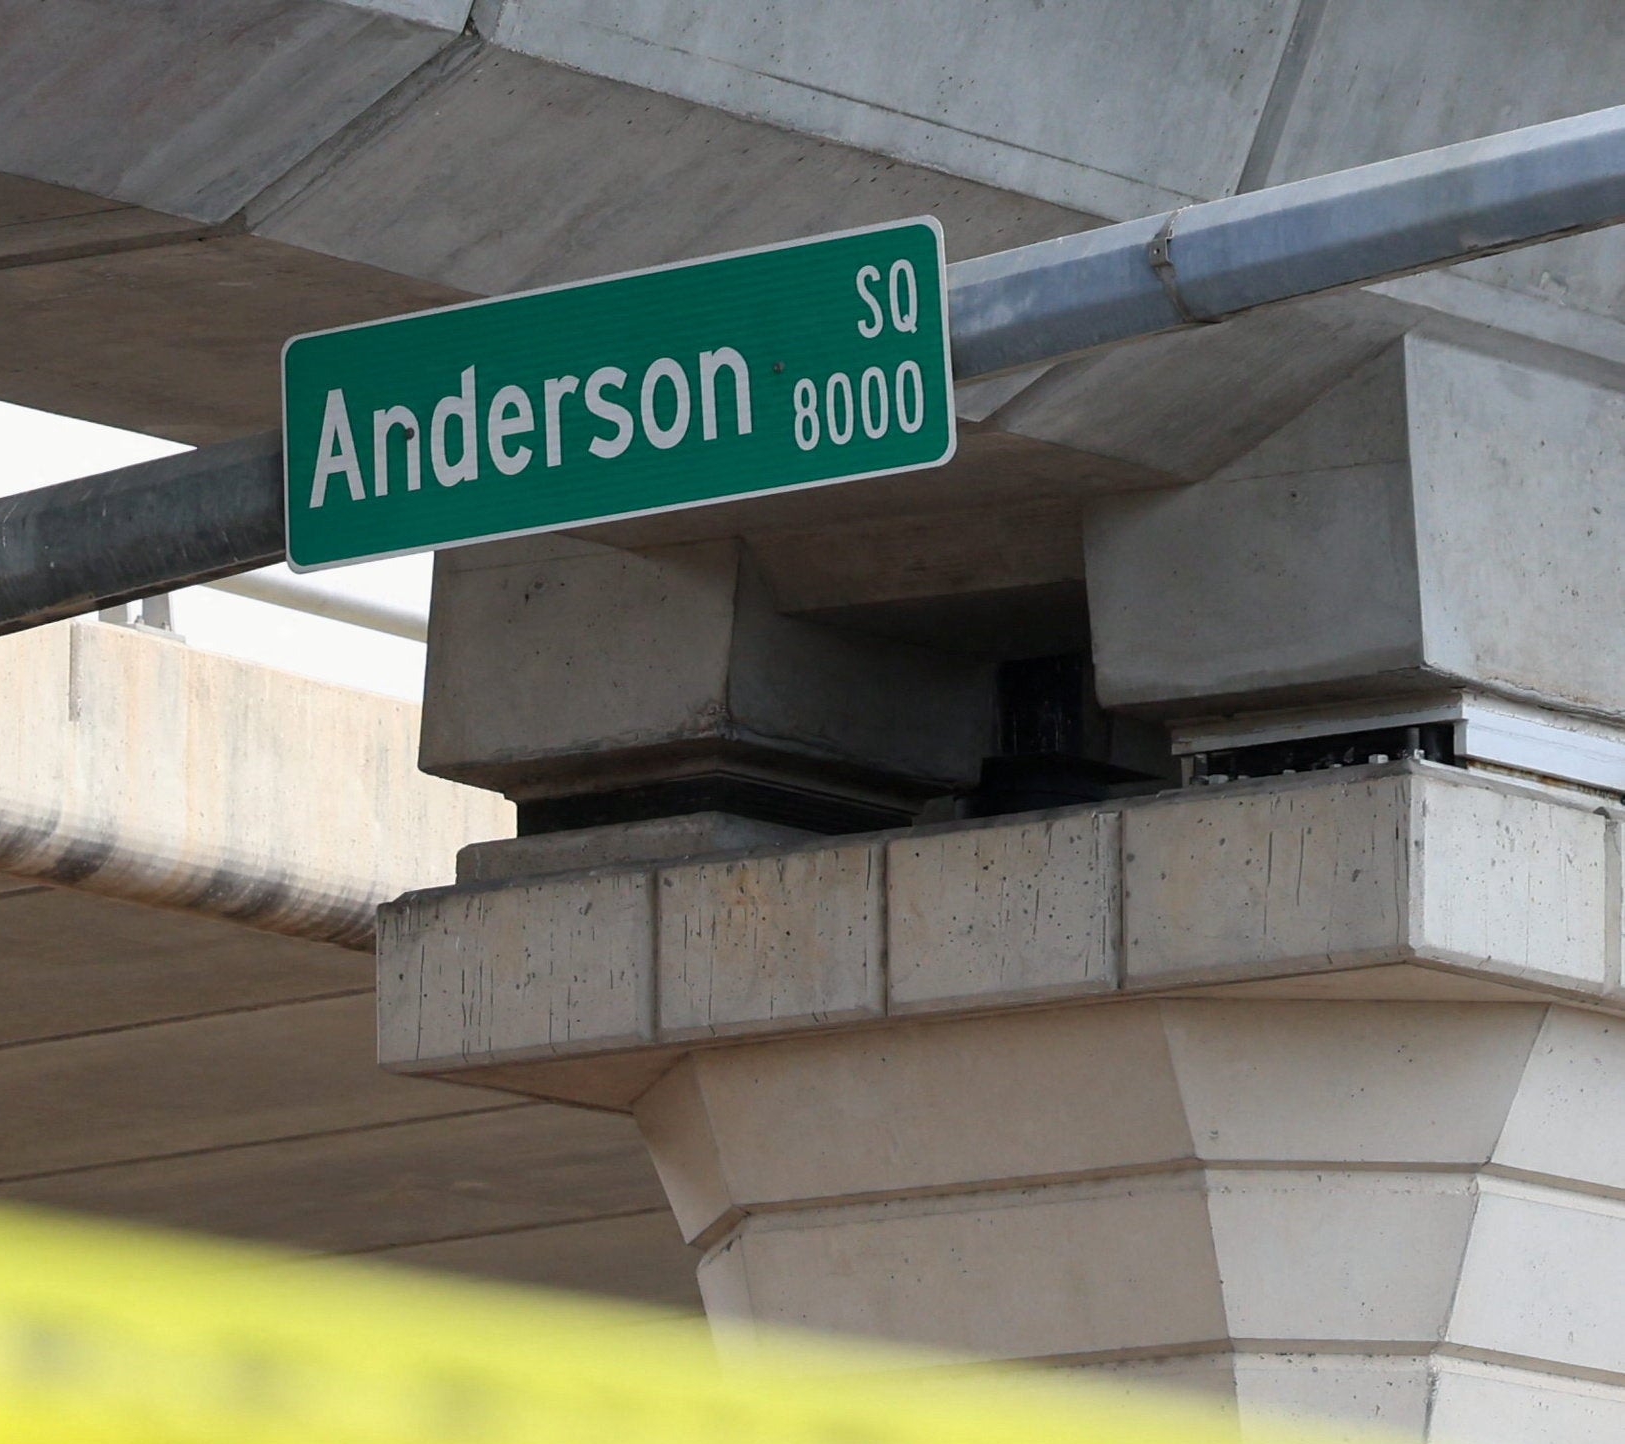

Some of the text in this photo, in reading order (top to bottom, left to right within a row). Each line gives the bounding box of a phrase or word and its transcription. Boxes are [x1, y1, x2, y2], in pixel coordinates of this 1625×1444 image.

[854, 257, 919, 340] SQ
[308, 344, 753, 509] Anderson
[792, 359, 925, 451] 8000
